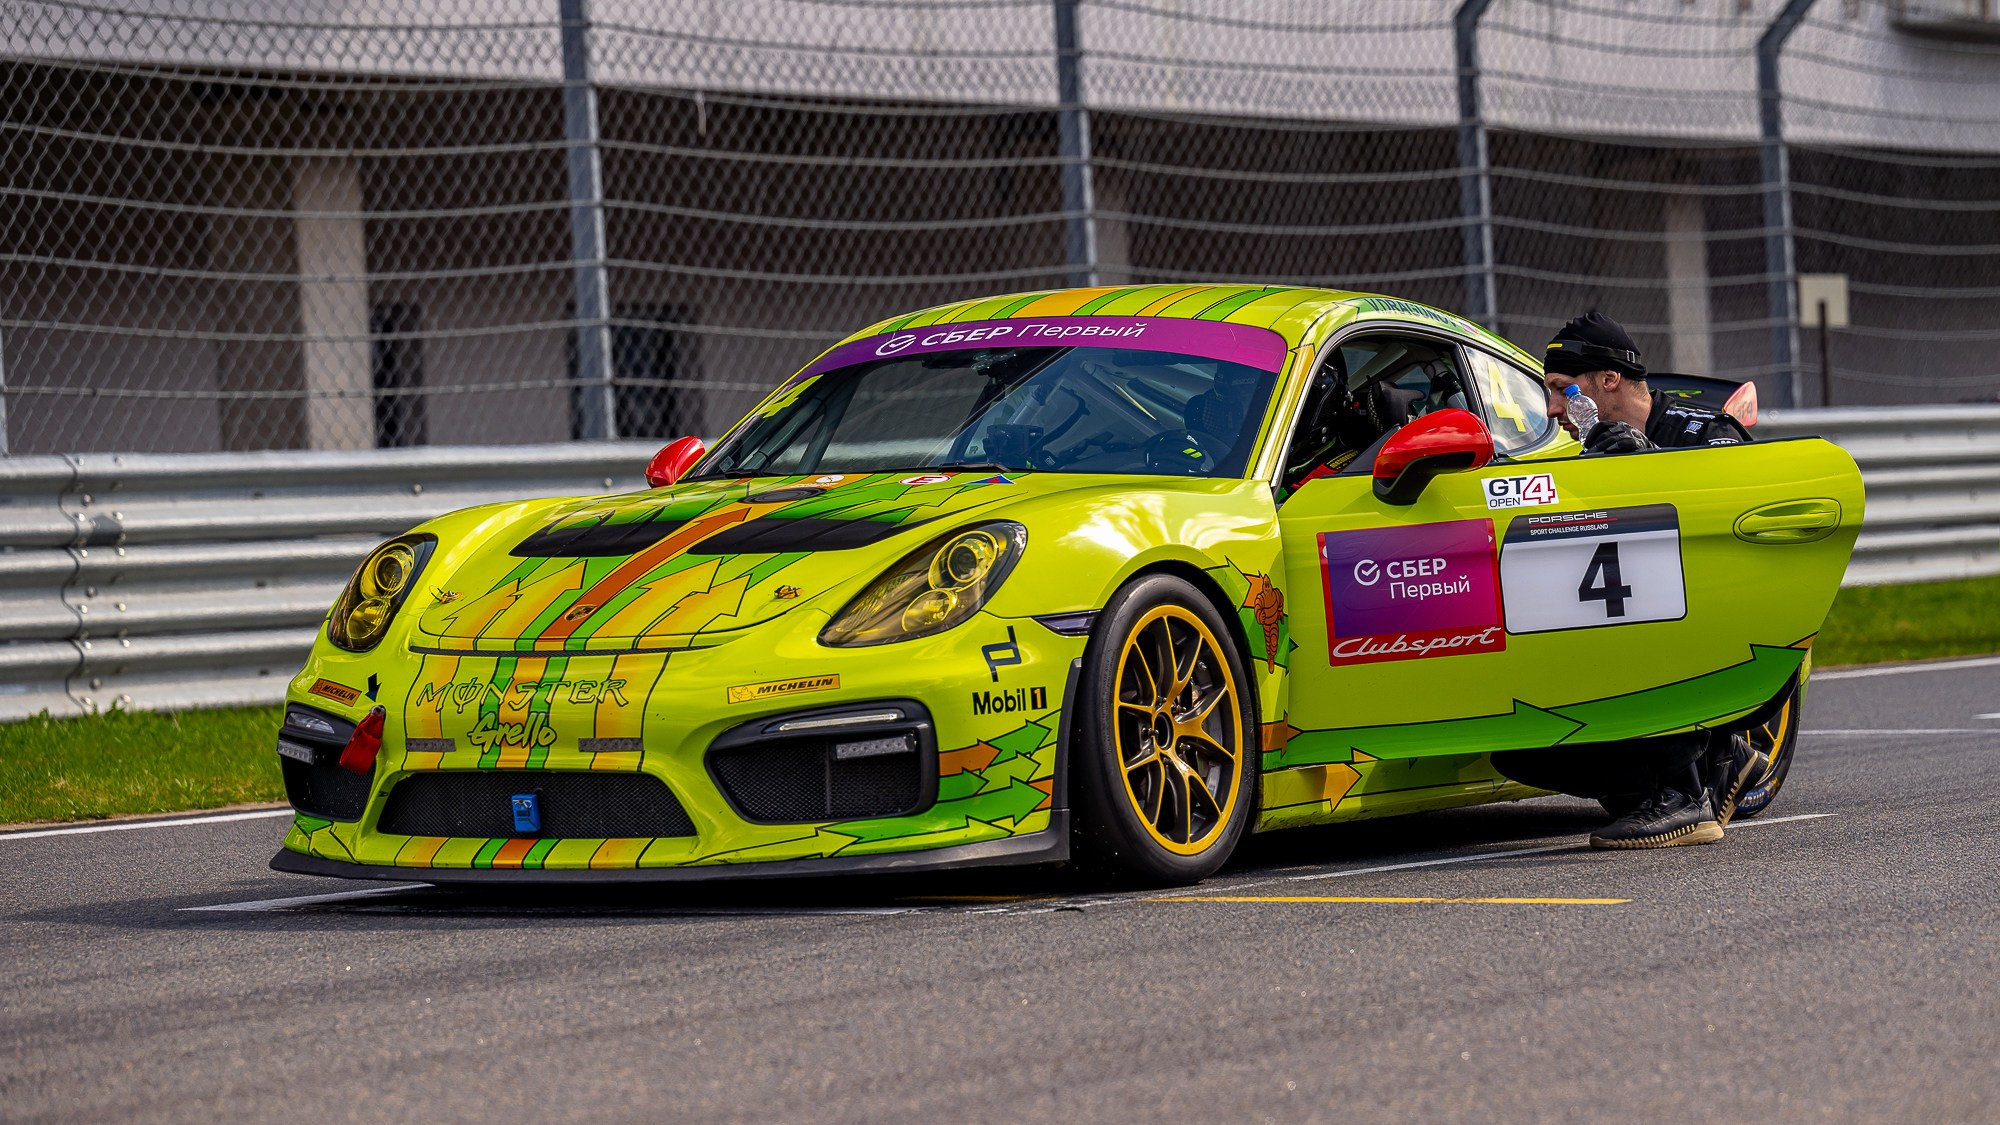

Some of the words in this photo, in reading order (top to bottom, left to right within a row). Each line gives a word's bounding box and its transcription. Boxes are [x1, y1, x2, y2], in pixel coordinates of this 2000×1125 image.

[921, 326, 1013, 347] СБЕР
[1016, 322, 1147, 338] Первый
[1487, 361, 1526, 433] 4
[1489, 497, 1521, 508] OPEN
[1528, 511, 1608, 524] PORSCHE
[1530, 528, 1548, 536] SPORT
[1548, 525, 1579, 535] CHALLENGE
[1580, 523, 1609, 532] RUSSLAND
[1386, 558, 1447, 579] СБЕР
[1578, 541, 1632, 618] 4
[1390, 575, 1470, 601] Первый
[1333, 626, 1502, 658] Clubsport
[321, 684, 357, 701] MICHELIN
[756, 677, 834, 695] MICHELIN
[972, 688, 1027, 716] Mobil
[467, 710, 558, 755] Grello
